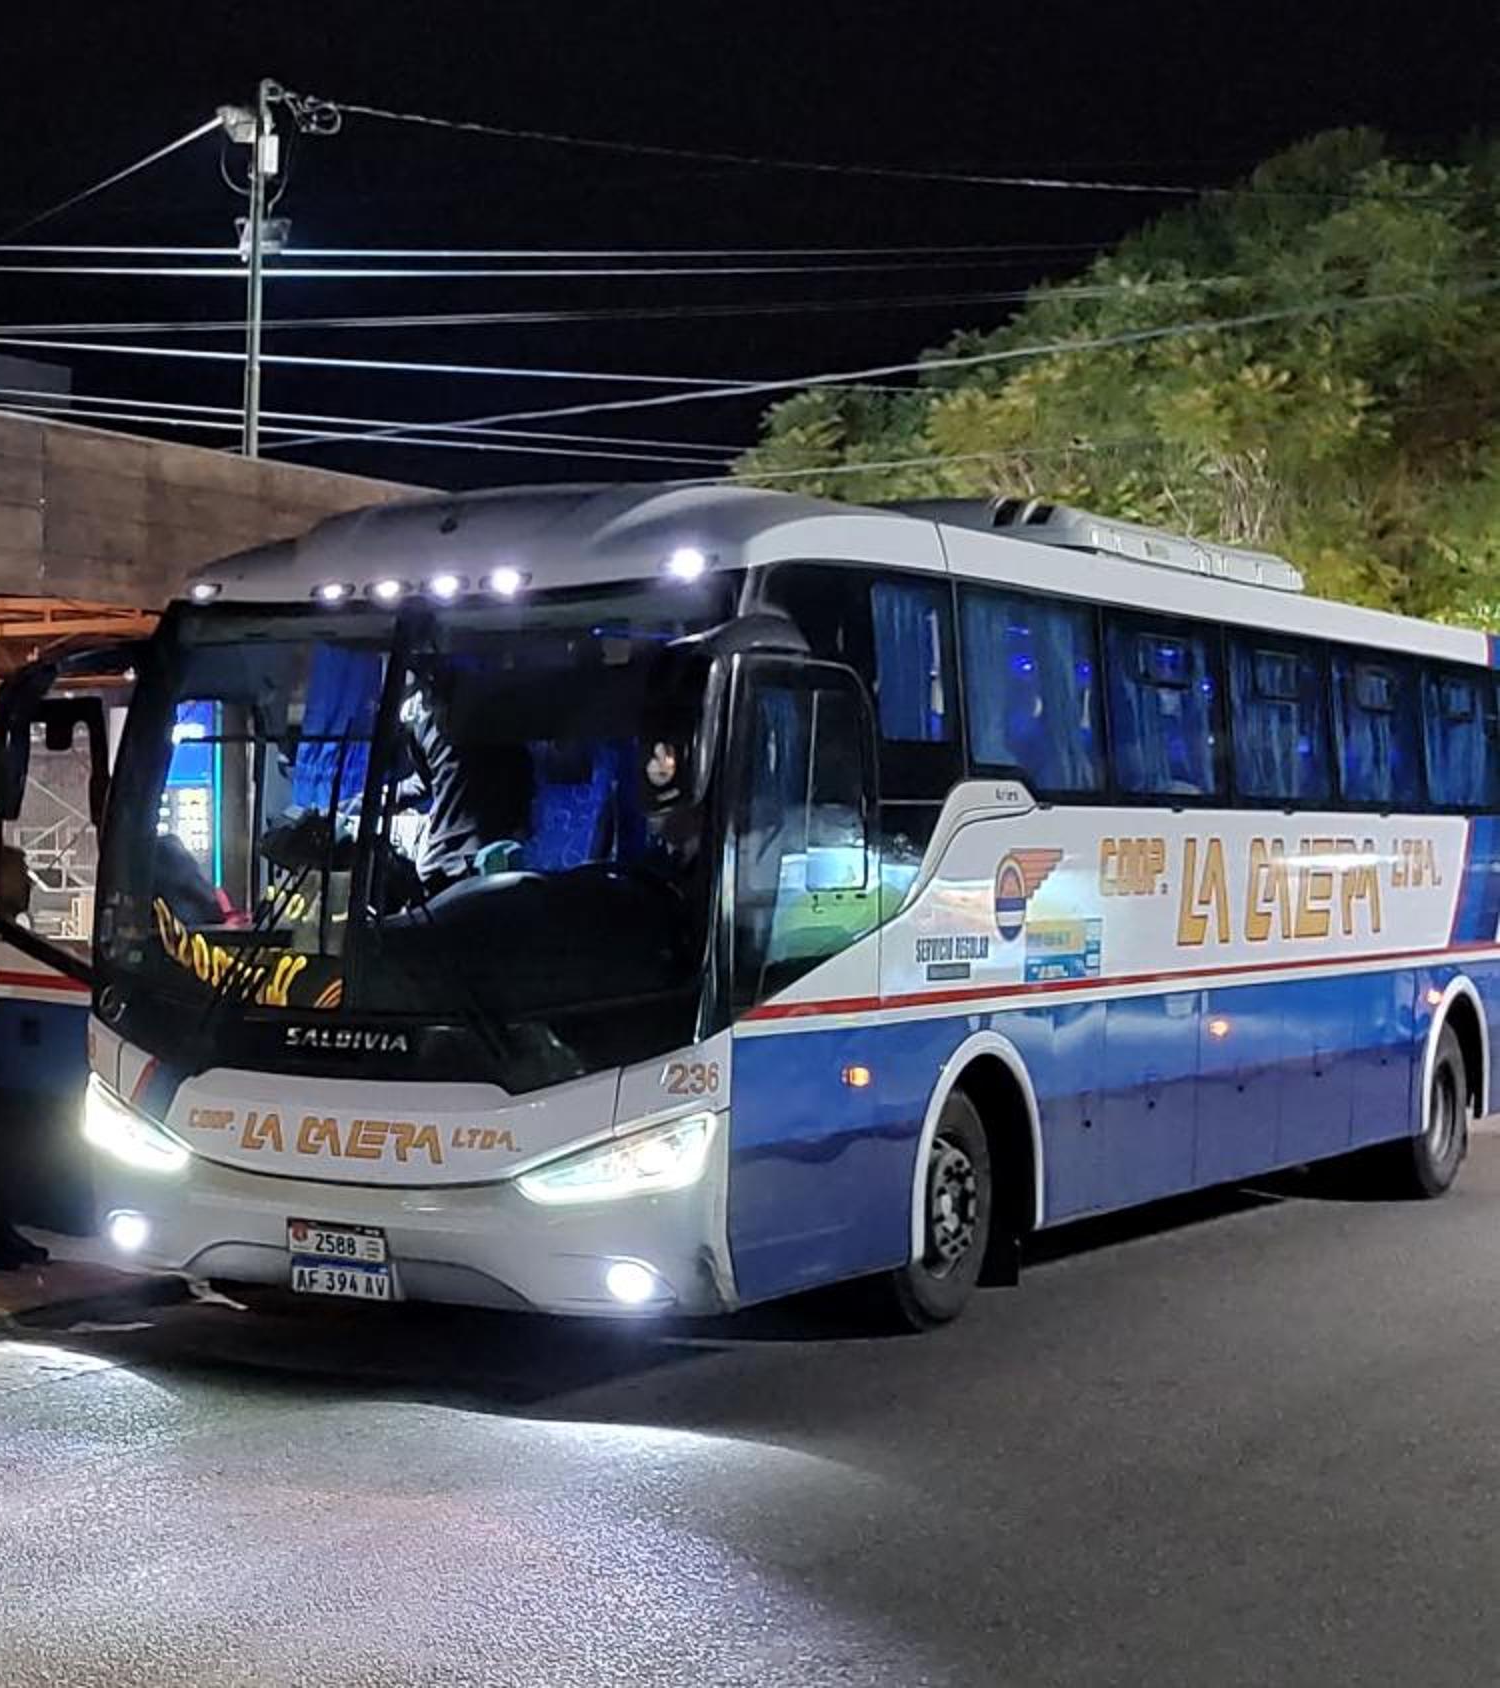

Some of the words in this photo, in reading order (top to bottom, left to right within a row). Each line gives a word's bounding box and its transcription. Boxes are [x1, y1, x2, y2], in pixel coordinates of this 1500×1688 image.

[1177, 837, 1230, 947] LA
[1244, 837, 1382, 942] CALERA
[915, 936, 954, 963] SERVICIO
[285, 1027, 408, 1052] SALDIVIA
[667, 1061, 720, 1095] 236
[240, 1110, 284, 1153] LA
[296, 1114, 444, 1165] CALERA
[451, 1125, 523, 1153] LTDA.
[315, 1233, 357, 1255] 2588
[297, 1269, 319, 1290] AF
[325, 1271, 358, 1293] 394
[365, 1276, 385, 1297] AV
